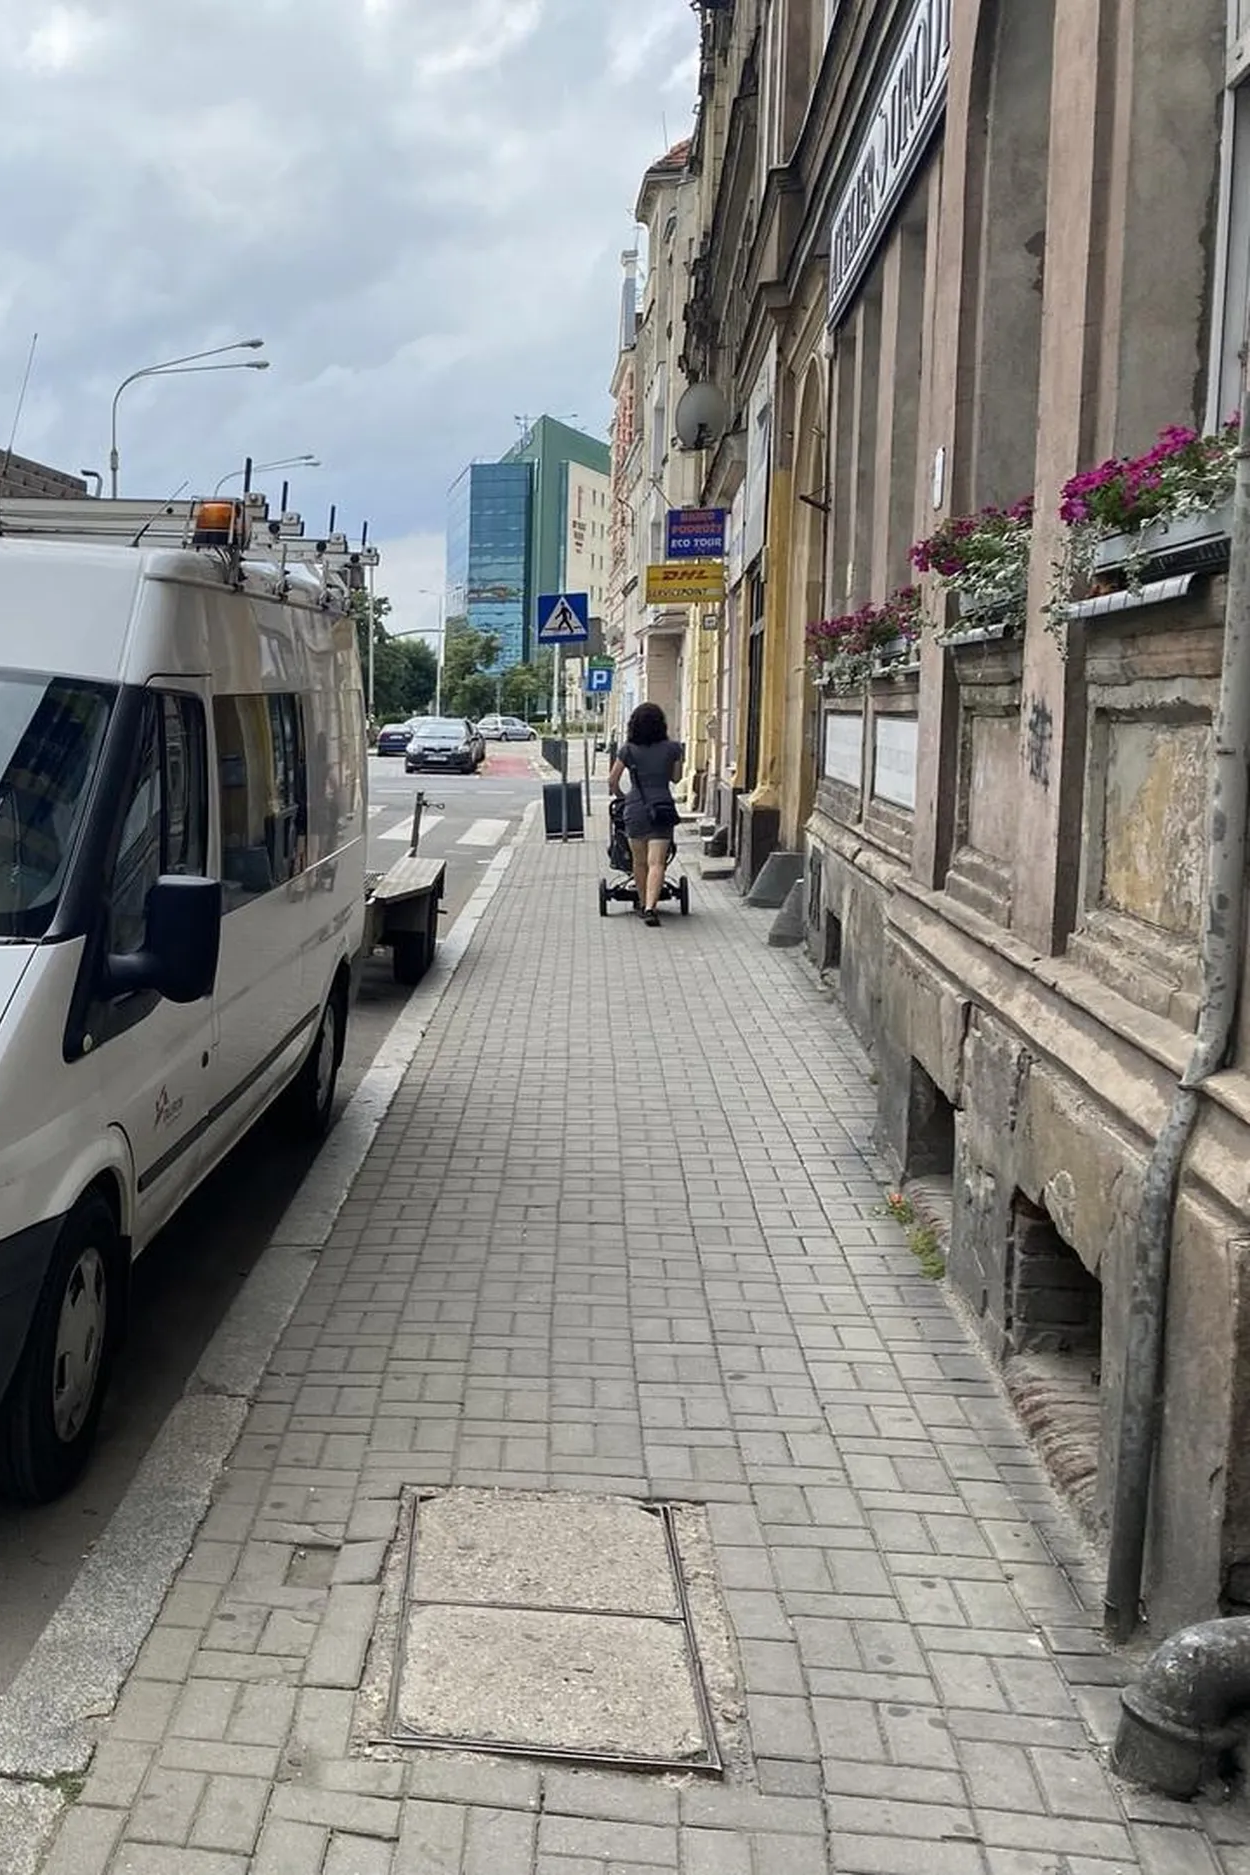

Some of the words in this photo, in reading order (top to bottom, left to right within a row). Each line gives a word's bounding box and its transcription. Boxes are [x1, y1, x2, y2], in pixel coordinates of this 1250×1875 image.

[671, 538, 691, 549] ECO
[693, 537, 723, 548] TOUR
[662, 570, 709, 581] DHL
[592, 670, 608, 690] P
